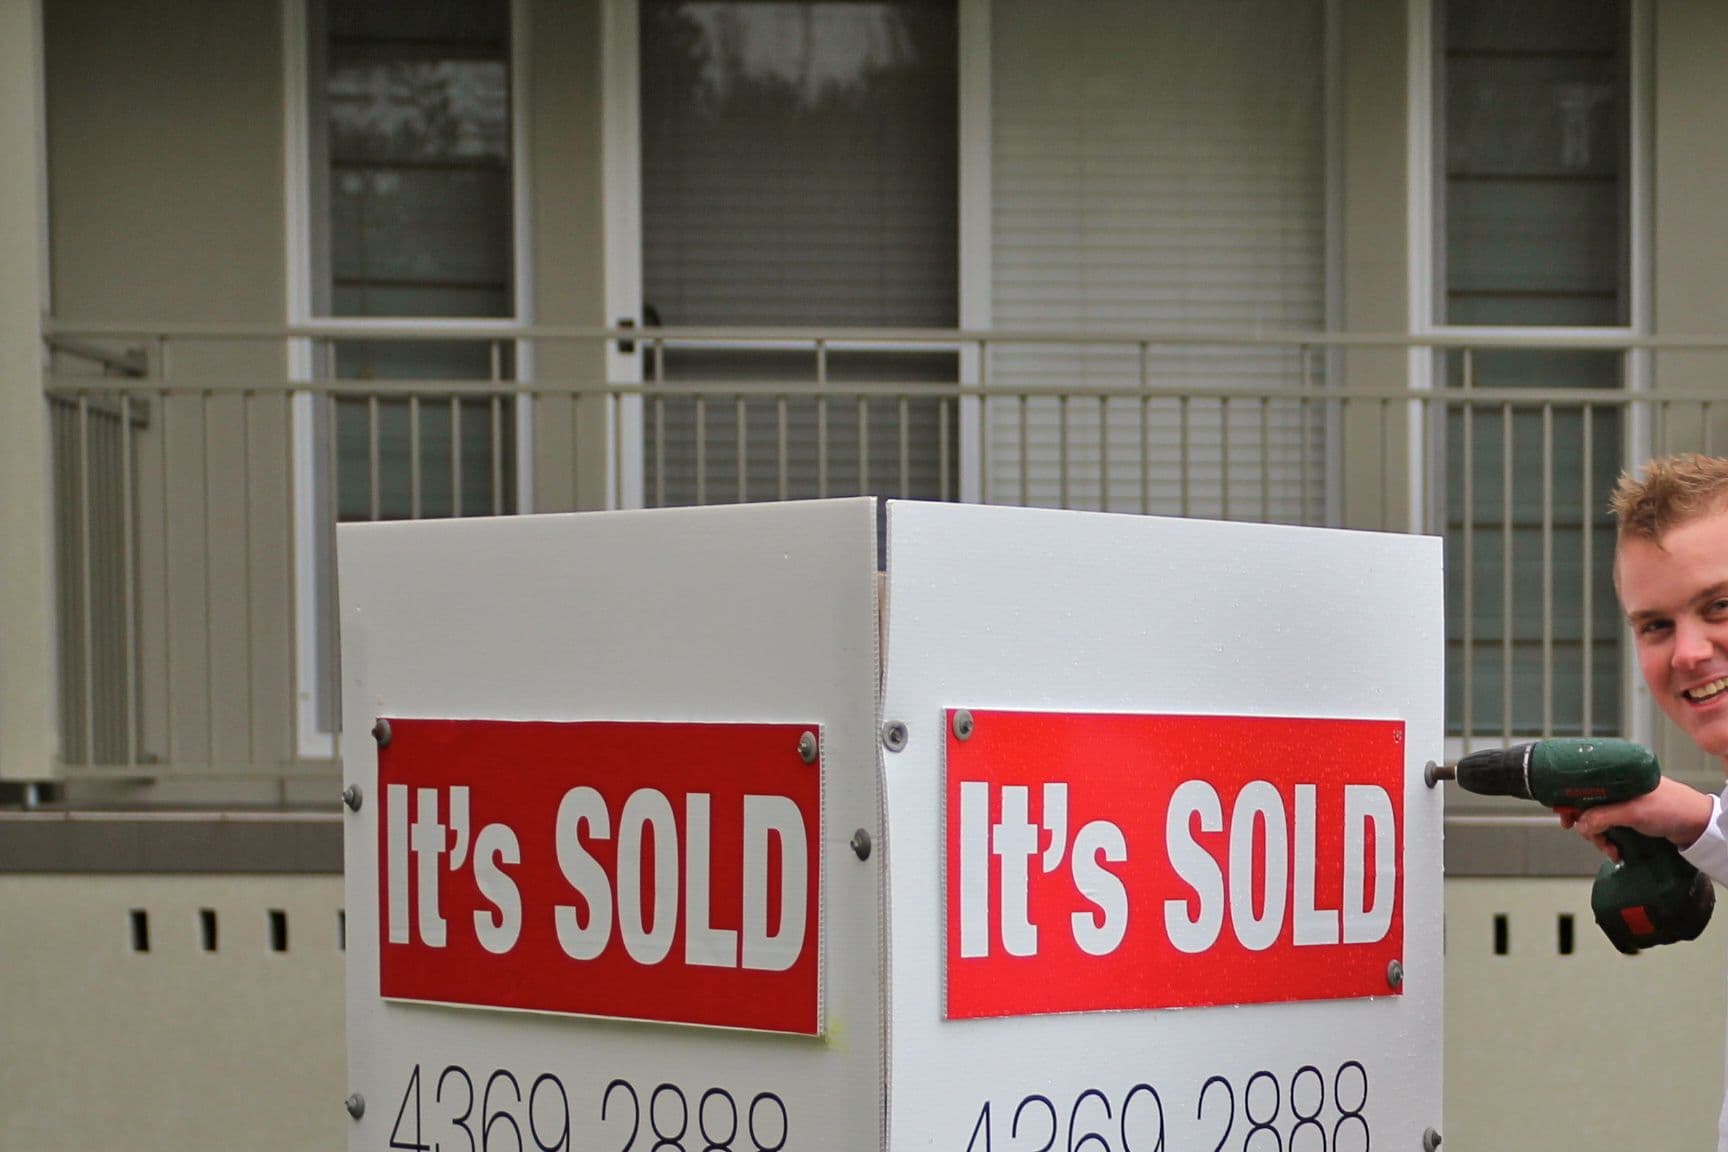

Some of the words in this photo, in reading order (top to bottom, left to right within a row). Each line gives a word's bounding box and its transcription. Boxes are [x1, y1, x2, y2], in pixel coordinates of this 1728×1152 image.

[386, 783, 523, 955] It's
[553, 786, 808, 972] SOLD
[960, 781, 1128, 959] It's
[1163, 779, 1396, 954] SOLD
